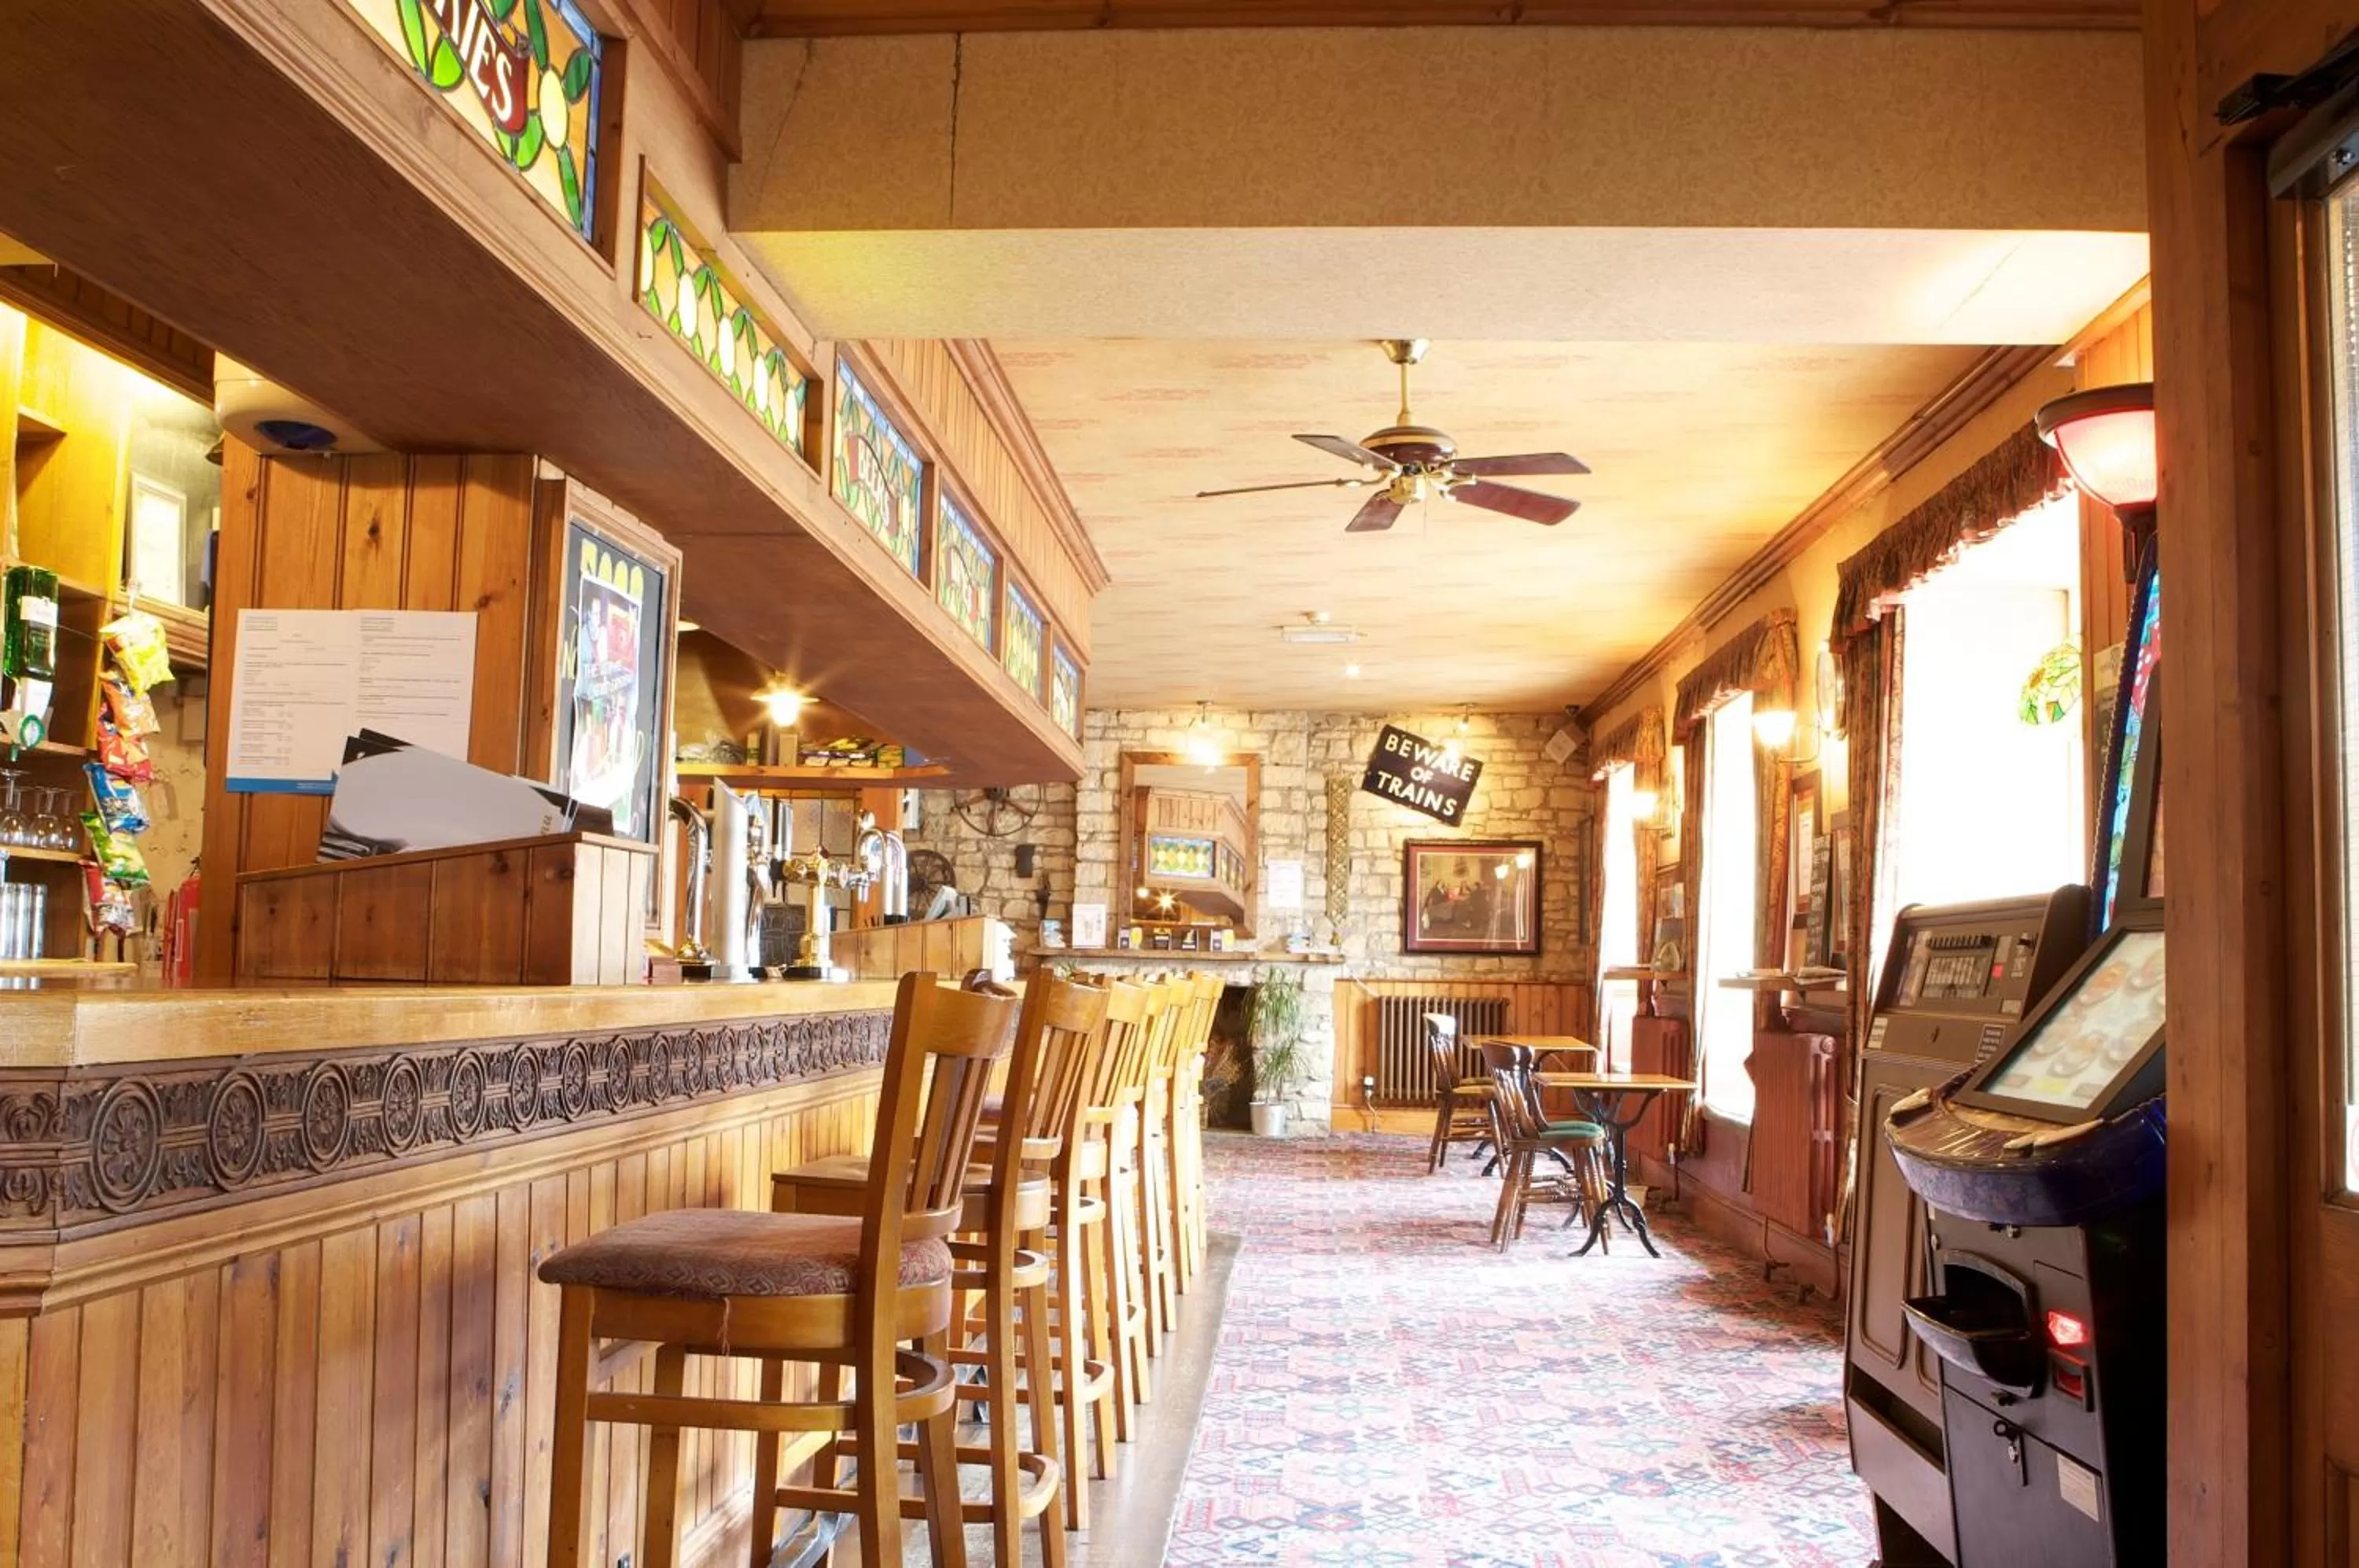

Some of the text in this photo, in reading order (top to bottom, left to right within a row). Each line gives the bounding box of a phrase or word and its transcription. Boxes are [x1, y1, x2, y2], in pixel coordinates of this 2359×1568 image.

[1385, 733, 1474, 782] BEWARE
[1410, 766, 1434, 784] OF
[1377, 770, 1457, 816] TRAINS
